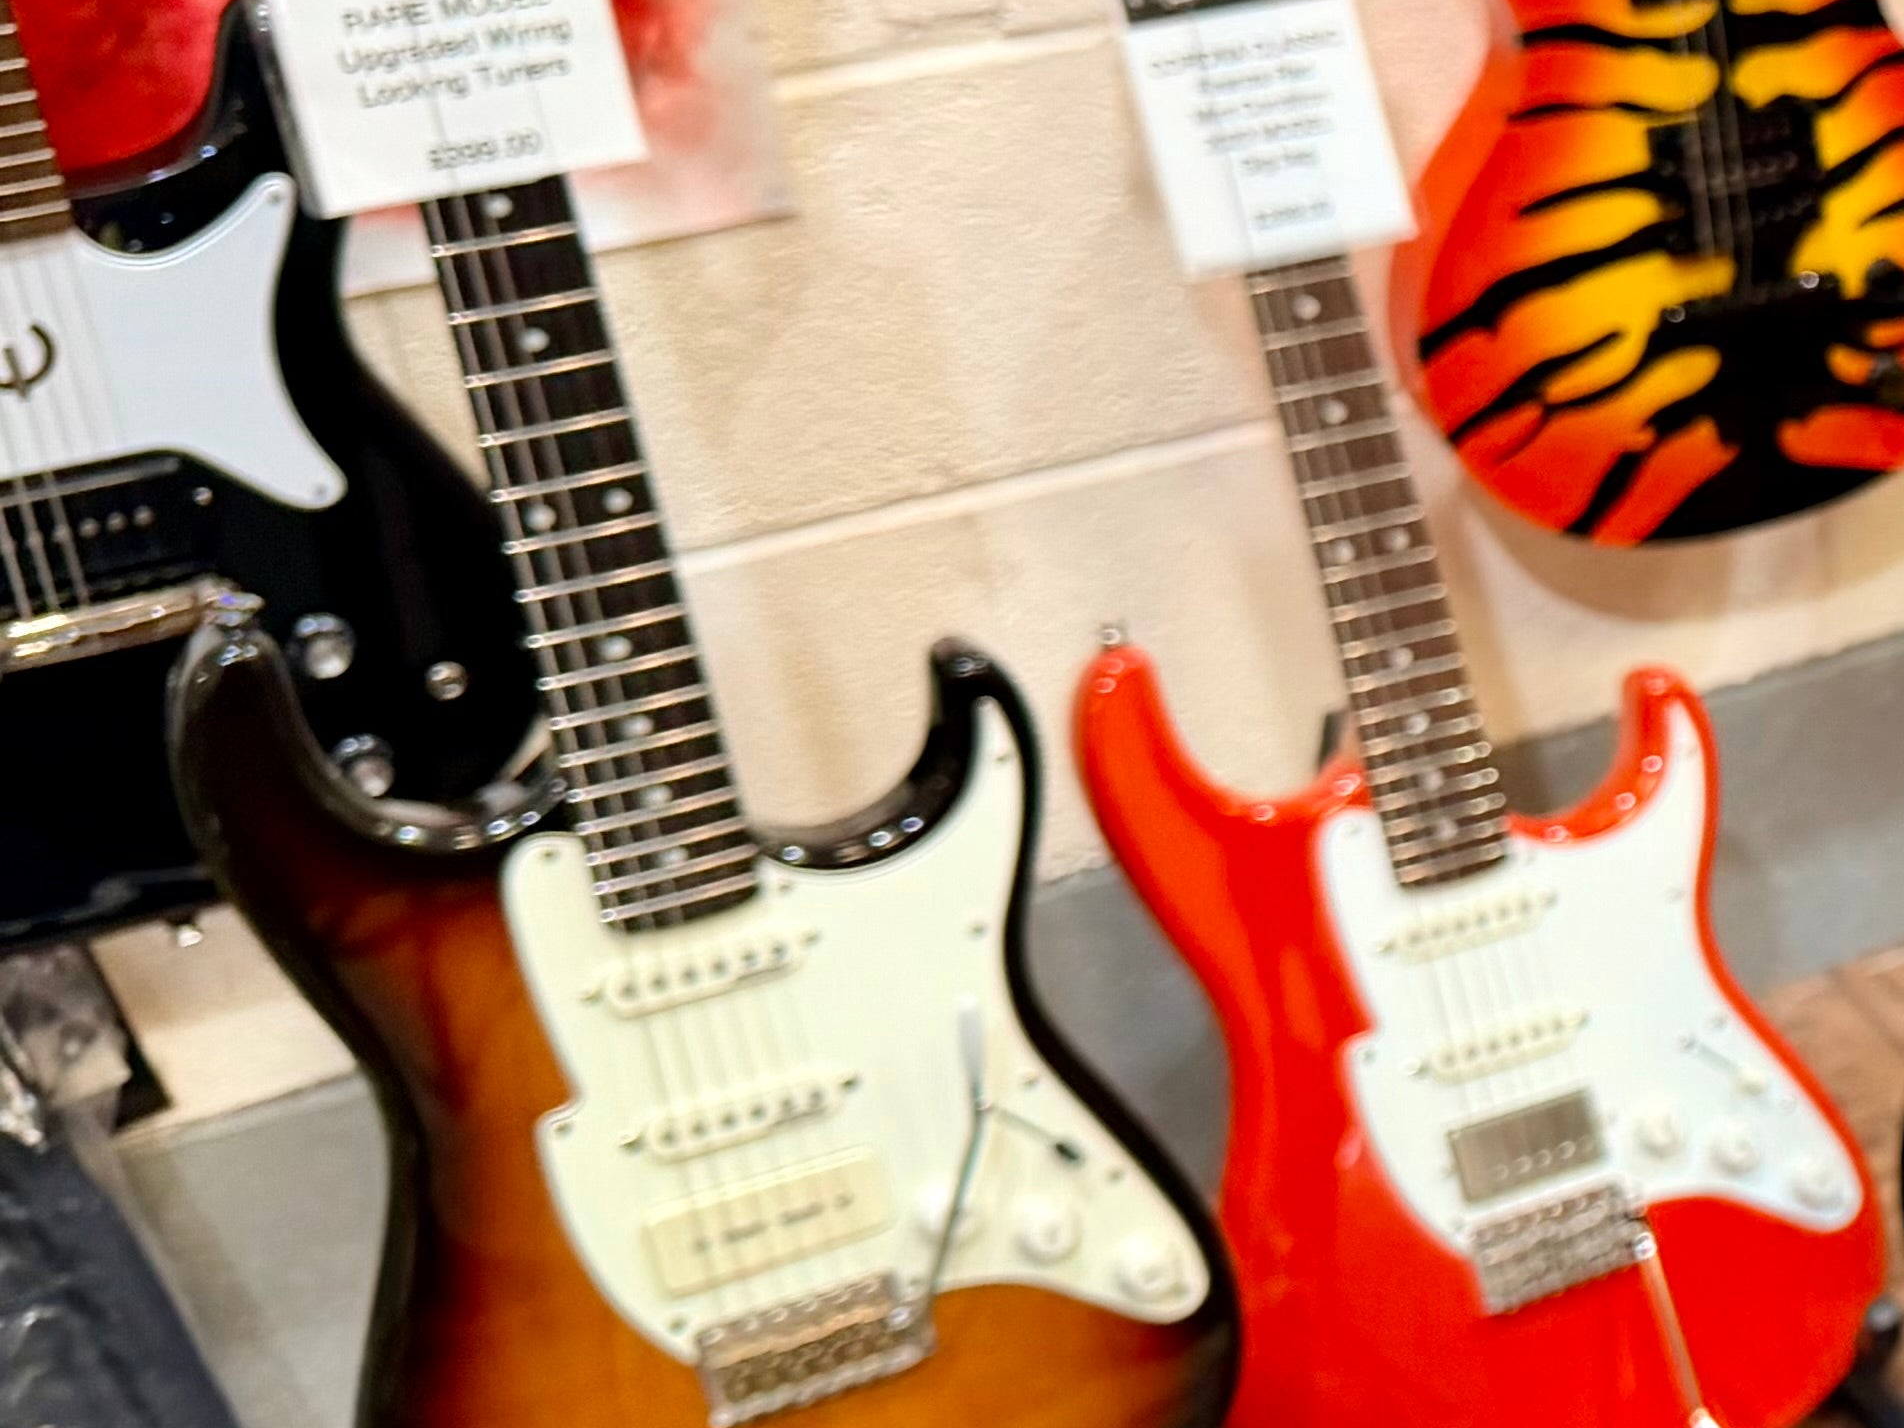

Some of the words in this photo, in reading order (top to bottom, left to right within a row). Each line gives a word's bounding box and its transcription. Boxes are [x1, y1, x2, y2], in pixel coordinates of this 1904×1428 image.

[342, 2, 432, 32] RARE
[336, 29, 480, 74] Upgraded
[357, 74, 471, 108] Locking
[479, 56, 570, 86] Tuners
